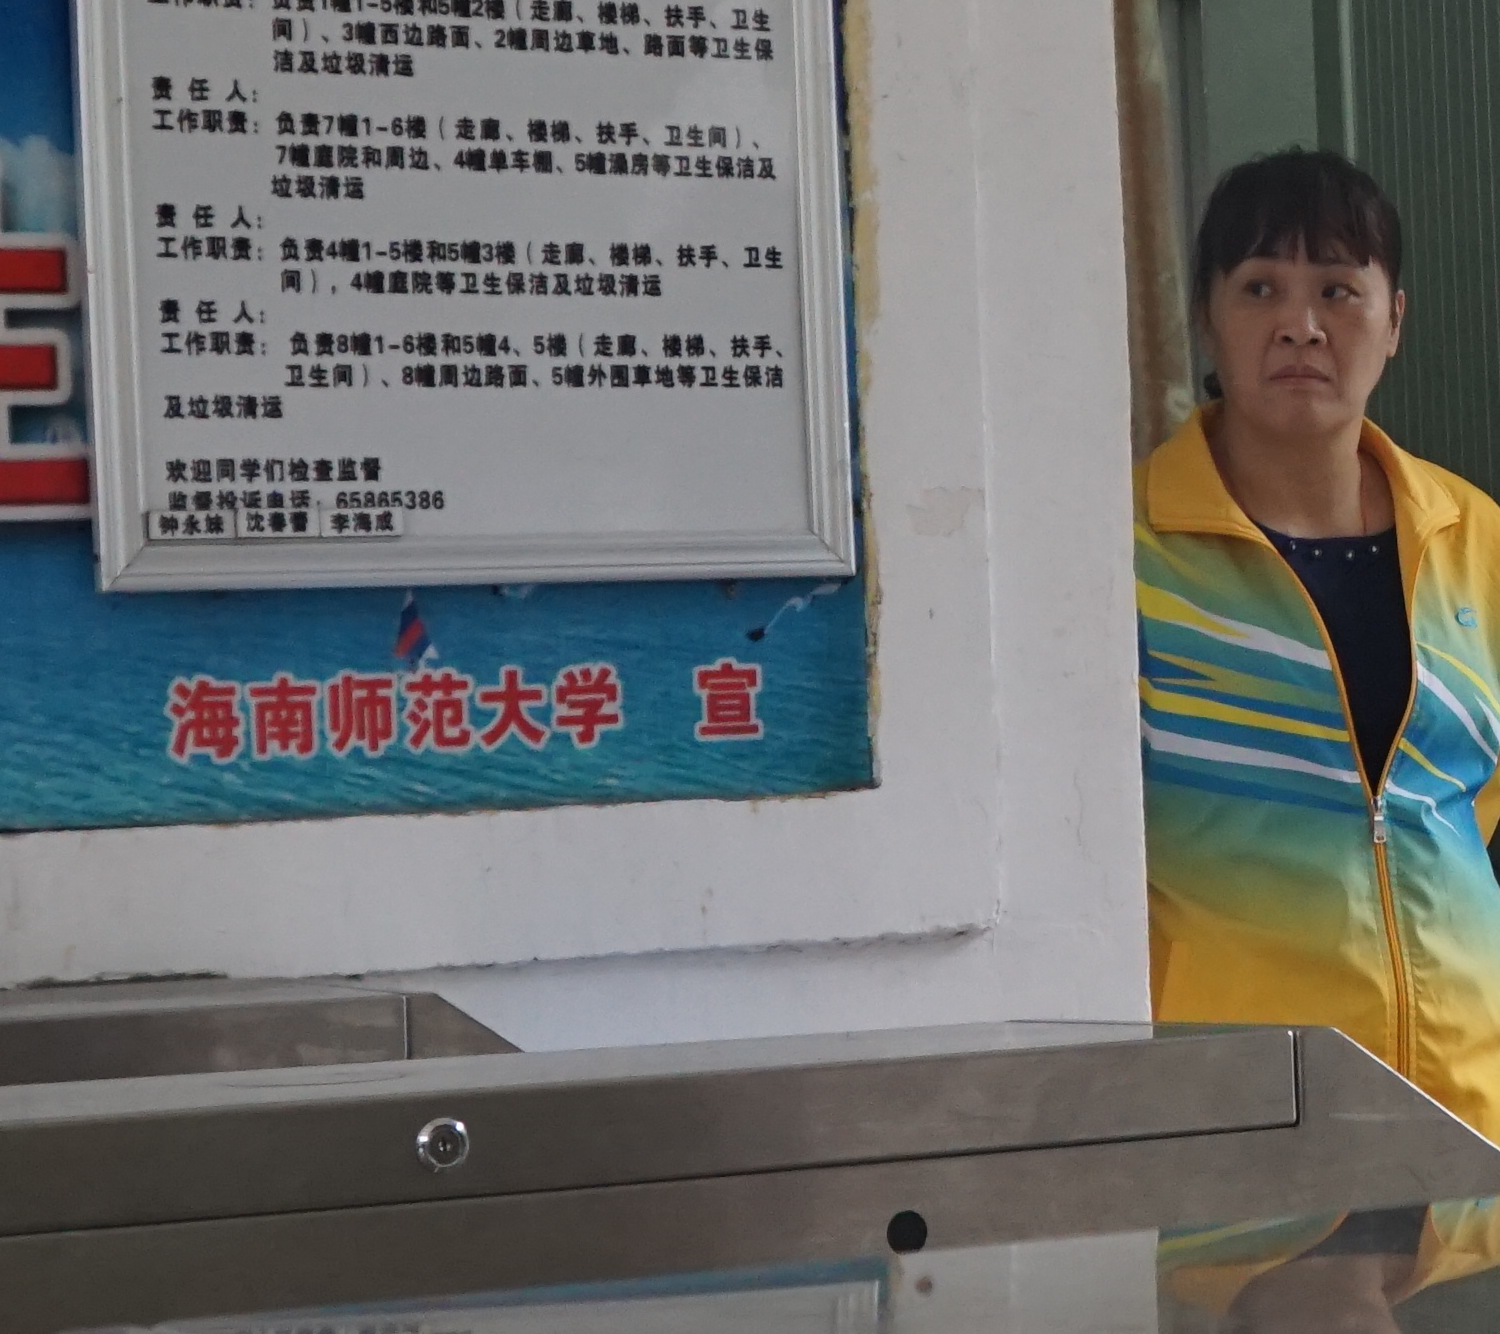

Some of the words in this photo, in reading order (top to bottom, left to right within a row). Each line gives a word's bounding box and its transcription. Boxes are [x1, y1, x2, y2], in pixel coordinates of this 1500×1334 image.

[273, 49, 415, 77] 洁及垃圾清运
[270, 174, 365, 200] 垃圾清运
[163, 394, 284, 419] 及垃圾清运
[165, 457, 382, 483] 欢迎同学们检查监督
[167, 664, 622, 764] 海南师范大学
[693, 659, 762, 740] 宣
